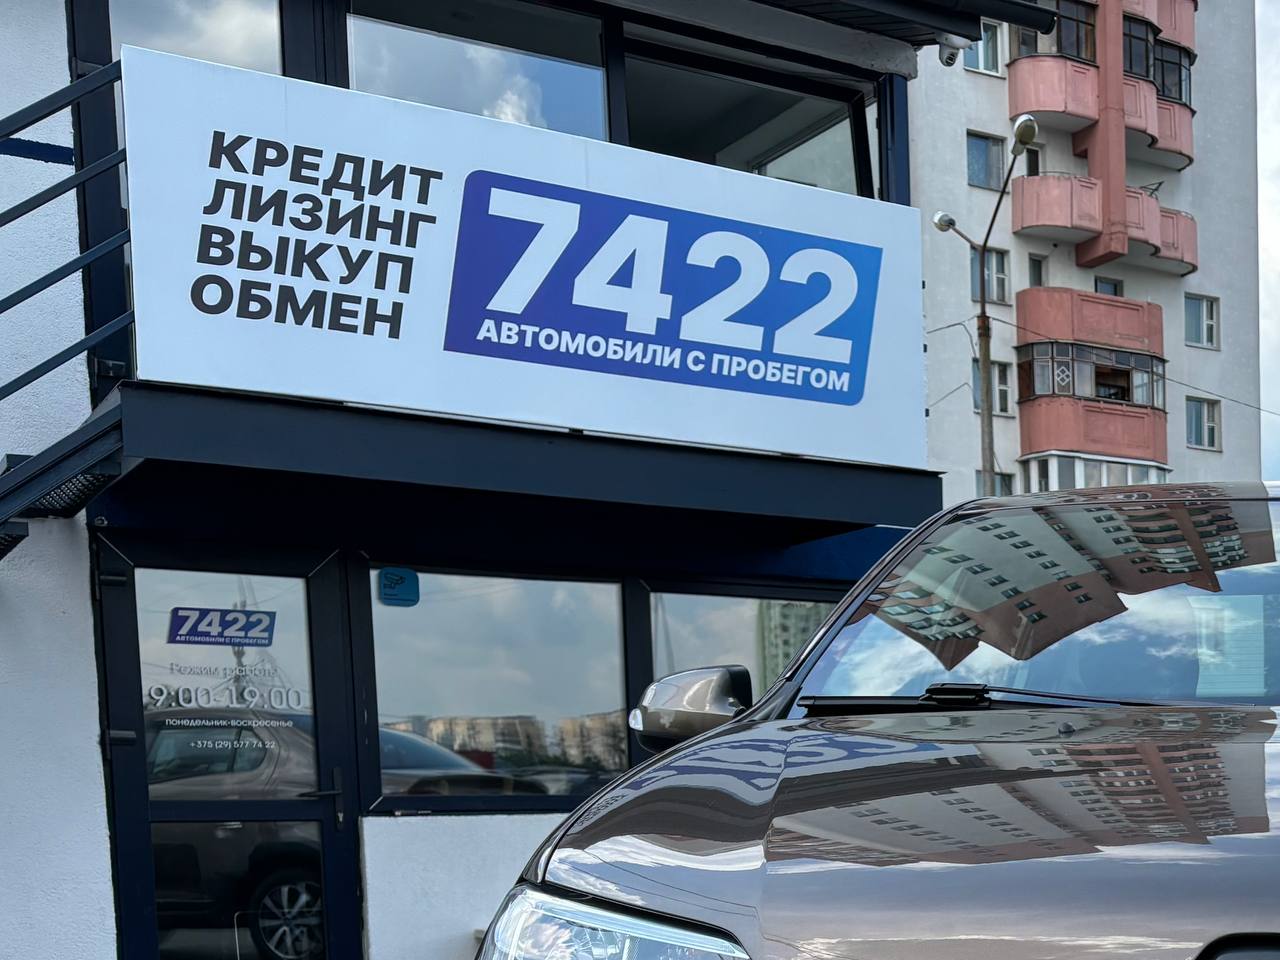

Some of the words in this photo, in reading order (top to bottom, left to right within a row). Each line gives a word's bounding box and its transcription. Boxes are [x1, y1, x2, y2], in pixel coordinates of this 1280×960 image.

[207, 130, 444, 207] КРЕДИТ
[201, 178, 437, 250] ЛИЗИНГ
[196, 224, 414, 295] ВЫКУП
[486, 189, 859, 364] 7422
[188, 273, 405, 340] ОБМЕН
[475, 319, 683, 370] АВТОМОБИЛИ
[687, 350, 706, 372] С
[711, 353, 851, 394] ПРОБЕГОМ
[177, 609, 271, 638] 7422
